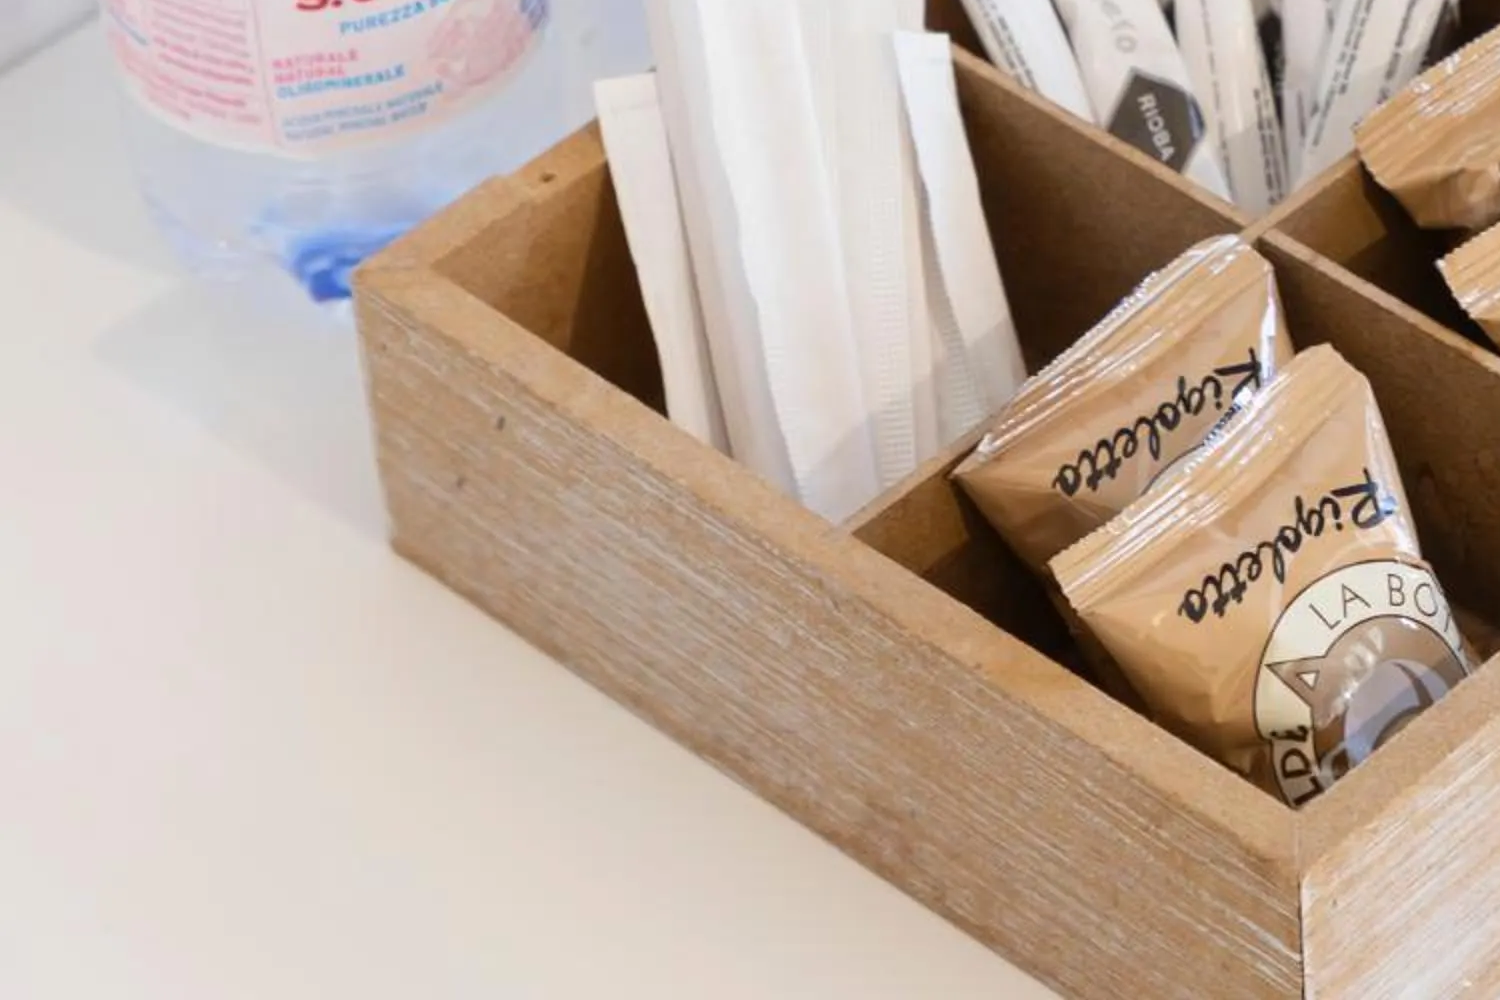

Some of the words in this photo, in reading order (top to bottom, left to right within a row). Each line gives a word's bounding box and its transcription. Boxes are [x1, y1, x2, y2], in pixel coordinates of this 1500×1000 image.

[340, 0, 425, 35] PUREZZA
[1137, 93, 1176, 163] RIOBA
[1177, 467, 1399, 624] Rigoletto
[1309, 582, 1371, 631] LA
